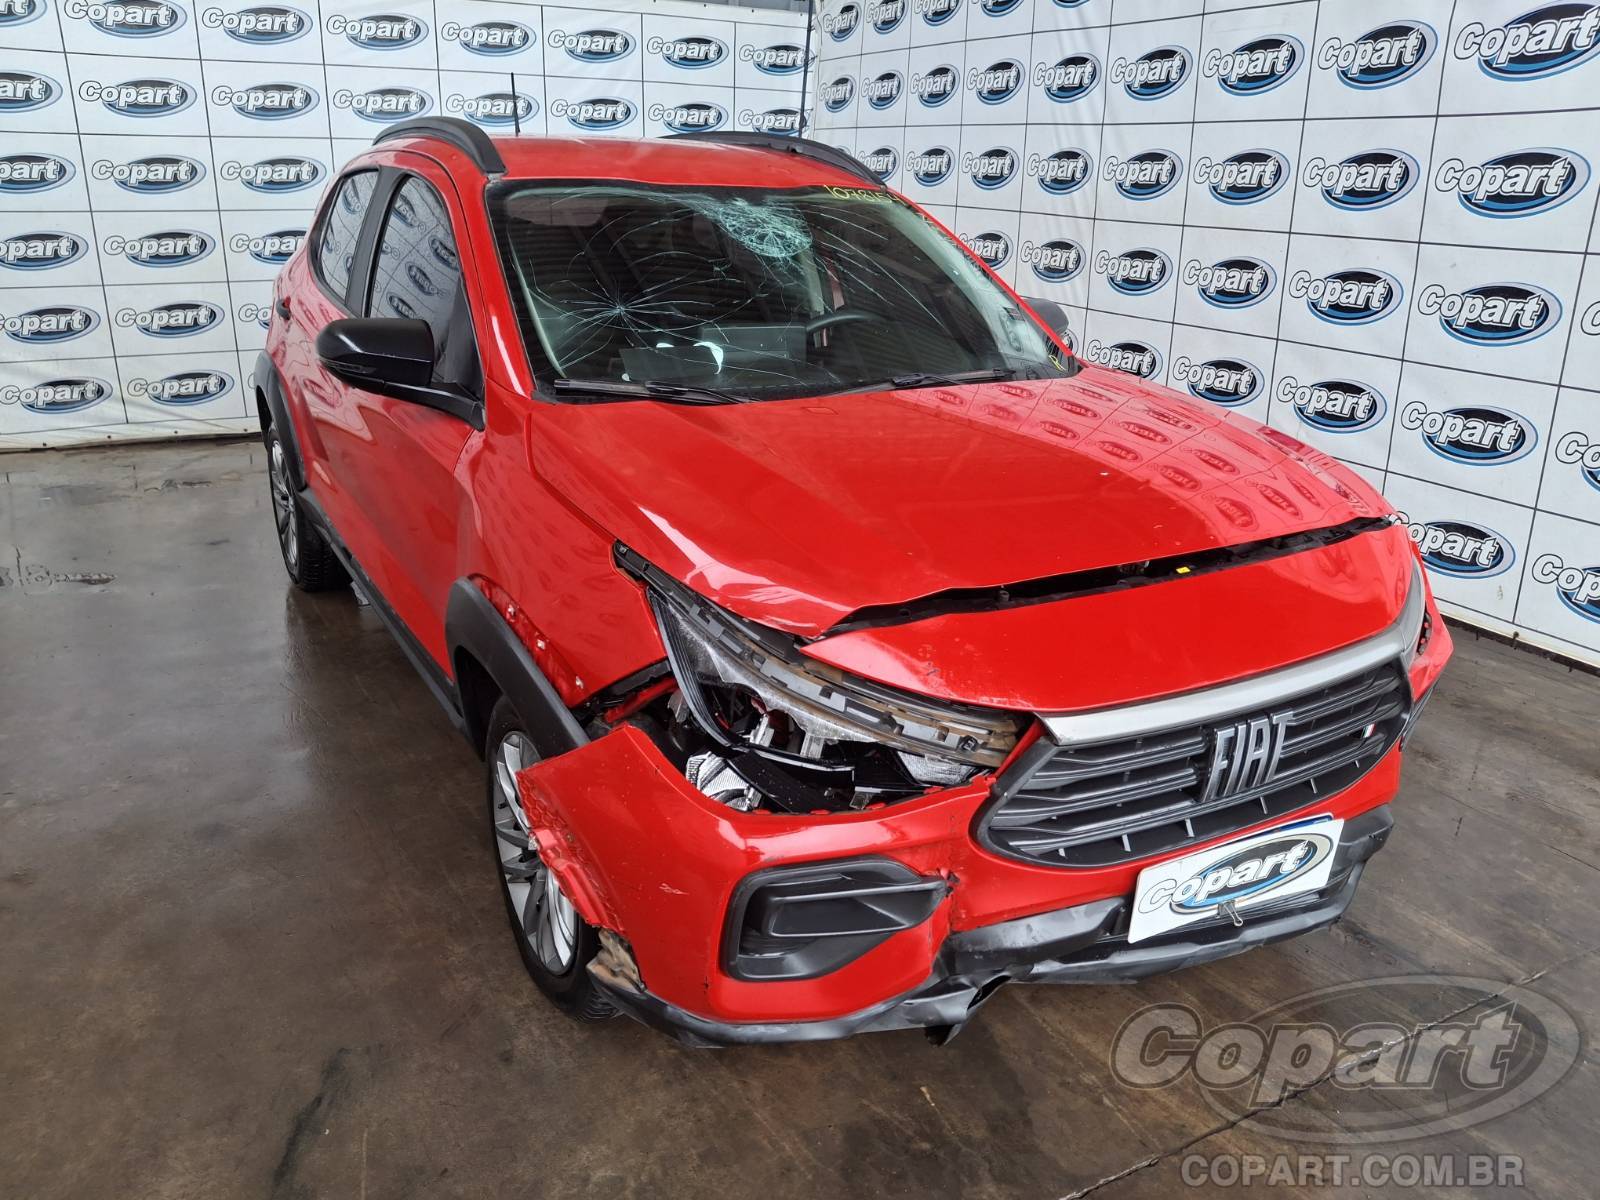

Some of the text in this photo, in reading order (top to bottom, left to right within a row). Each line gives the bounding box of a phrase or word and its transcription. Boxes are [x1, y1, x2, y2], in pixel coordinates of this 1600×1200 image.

[64, 0, 173, 26] Copart
[202, 8, 298, 34] Copart
[327, 15, 416, 41] Copart
[441, 22, 525, 46] Copart
[548, 30, 627, 53] Copart
[1454, 6, 1600, 68] Copart
[647, 37, 719, 61] Copart
[739, 44, 806, 69] Copart
[1203, 42, 1292, 84] Copart
[1318, 29, 1421, 77] Copart
[910, 69, 956, 98] Copart
[966, 63, 1020, 93] Copart
[1033, 59, 1094, 95] Copart
[1110, 51, 1186, 89] Copart
[0, 78, 45, 100] art
[79, 81, 184, 107] Copart
[212, 86, 305, 110] Copart
[333, 89, 420, 115] Copart
[861, 75, 901, 100] Copart
[446, 93, 528, 117] Copart
[551, 99, 627, 123] Copart
[648, 104, 721, 127] Copart
[0, 159, 60, 184] part
[92, 159, 192, 184] Copart
[221, 160, 313, 184] Copart
[905, 151, 951, 176] Copart
[961, 151, 1014, 180] Copart
[1026, 153, 1086, 183] Copart
[1103, 154, 1173, 187] Copart
[1193, 156, 1278, 193] Copart
[1303, 156, 1406, 196] Copart
[1435, 157, 1570, 203] Copart
[104, 235, 202, 259] Copart
[230, 233, 304, 256] Copa
[1020, 240, 1078, 271] Copart
[1095, 250, 1164, 282] Copart
[1183, 259, 1265, 295] Copart
[1289, 270, 1389, 310] Copart
[115, 302, 216, 329] Copart
[1418, 284, 1545, 330] Copart
[1086, 339, 1153, 375] Copart
[127, 374, 221, 401] Copart
[1173, 356, 1254, 396] Copart
[0, 379, 99, 408] Copart
[1276, 376, 1374, 421] Copart
[1401, 400, 1520, 452] Copart
[1532, 553, 1600, 603] Cop
[1203, 711, 1299, 803] FIAT
[1138, 840, 1310, 915] Copart
